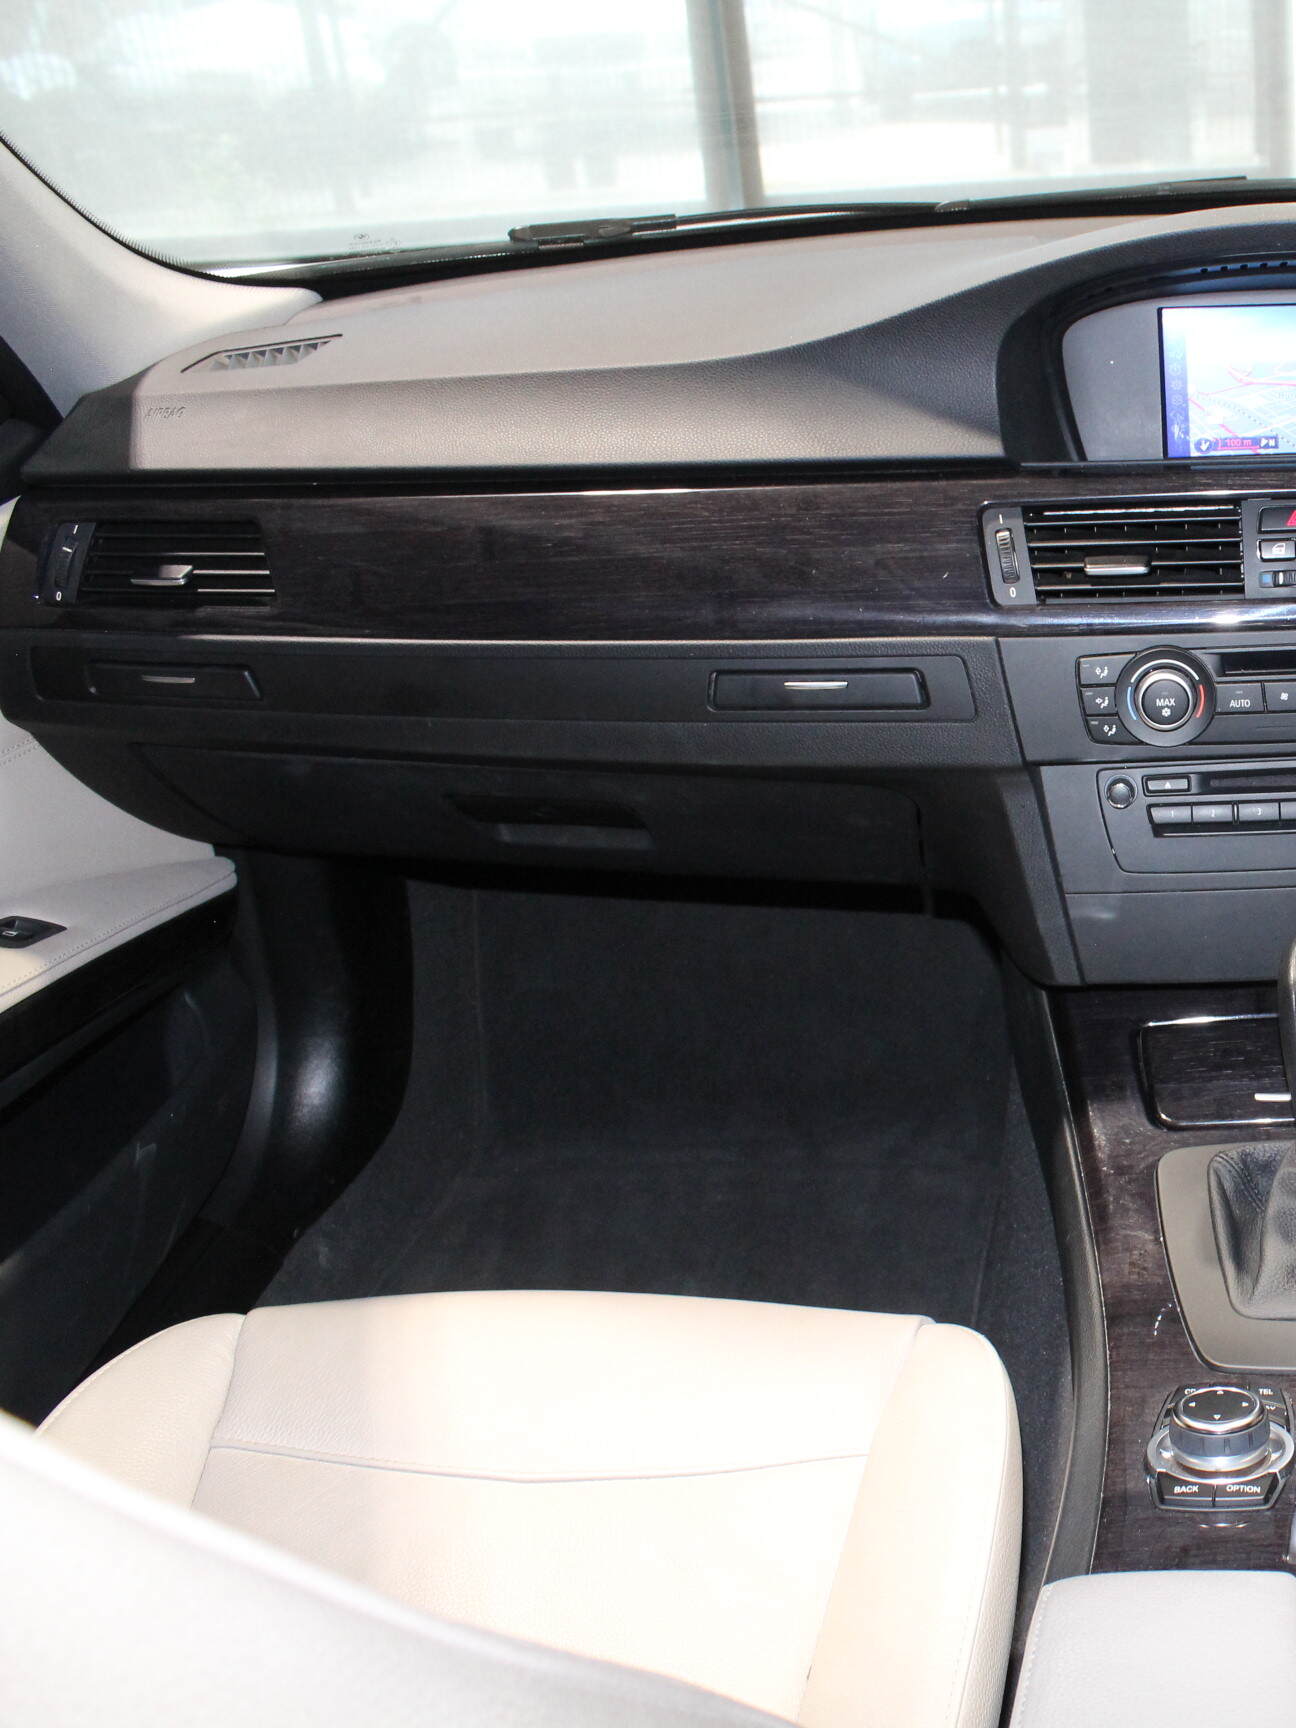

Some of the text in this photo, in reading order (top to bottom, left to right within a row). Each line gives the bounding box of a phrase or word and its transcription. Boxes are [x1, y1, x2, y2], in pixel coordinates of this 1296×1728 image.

[1155, 697, 1176, 707] MAX
[1229, 699, 1251, 708] AUTO
[1210, 809, 1215, 817] 2
[1257, 807, 1262, 815] 3
[1258, 1388, 1274, 1396] TEL
[1174, 1485, 1199, 1494] BACK
[1226, 1484, 1261, 1493] OPTION
